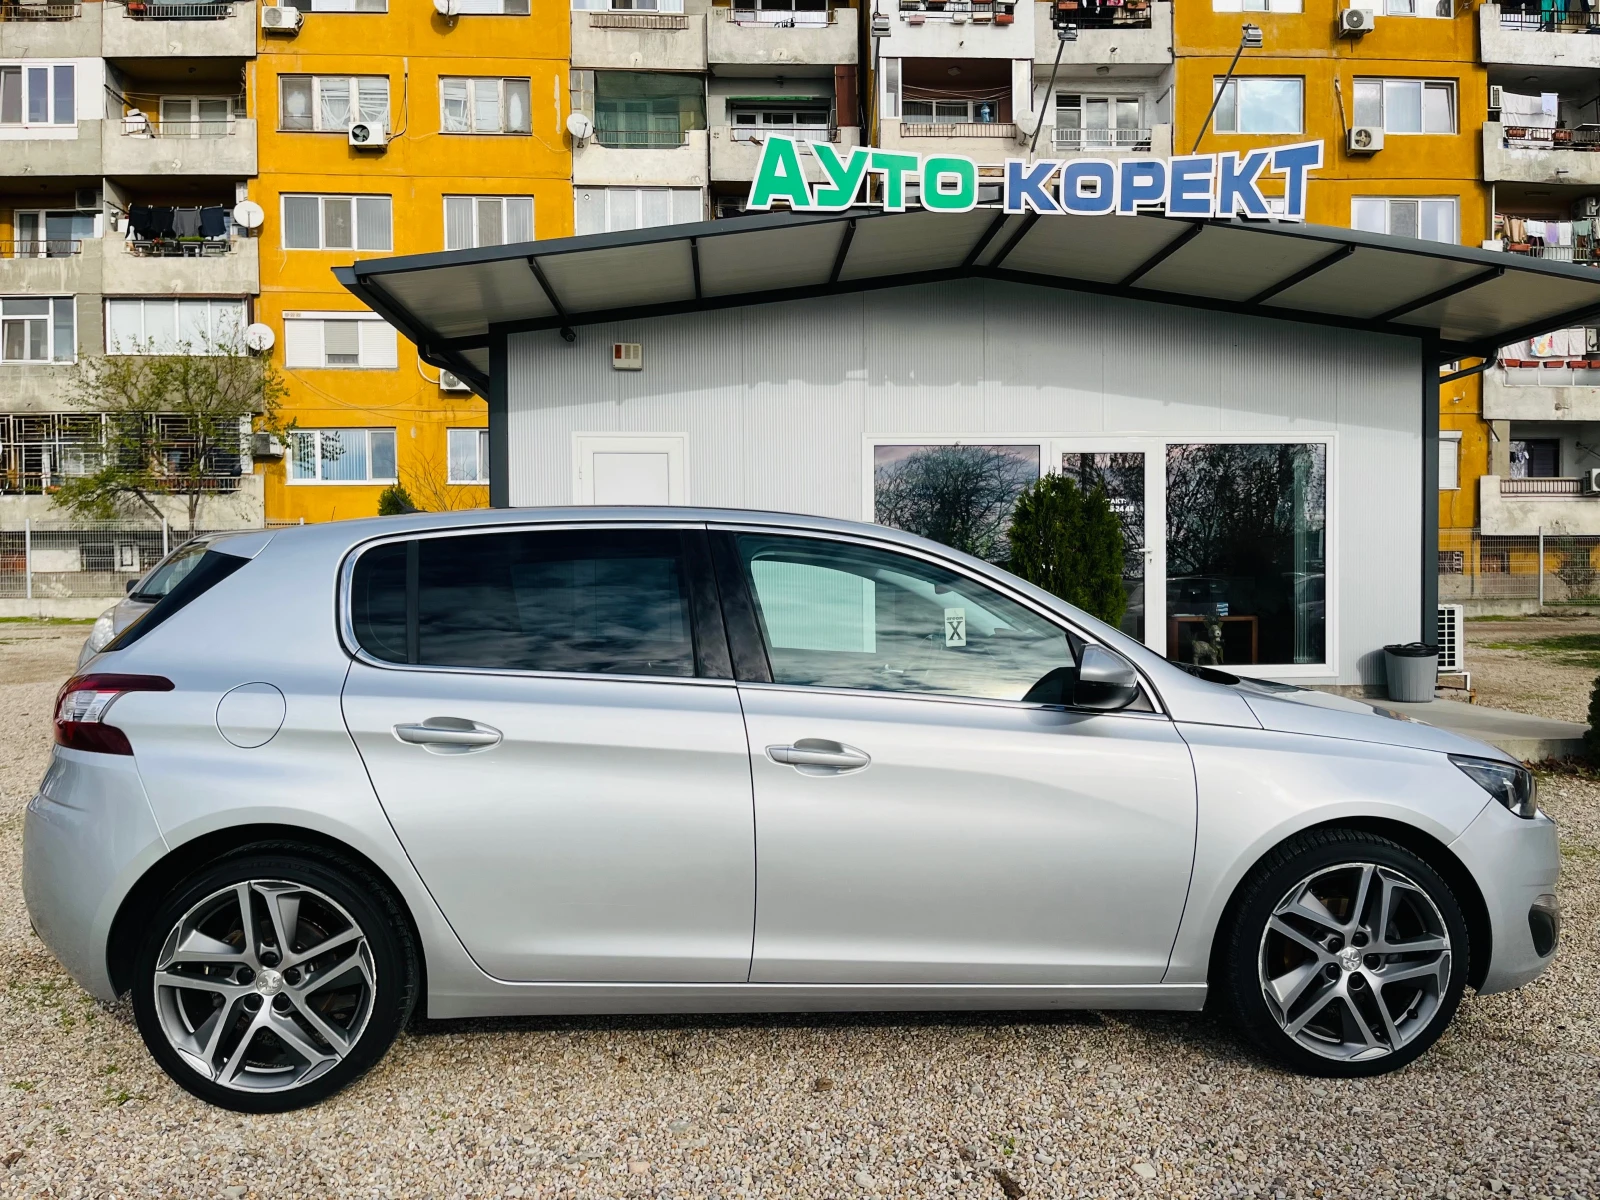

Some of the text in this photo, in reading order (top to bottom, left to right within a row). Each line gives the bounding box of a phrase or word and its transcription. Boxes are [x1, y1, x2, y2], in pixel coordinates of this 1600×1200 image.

[747, 132, 1324, 219] АУТО КОРЕКТ
[947, 621, 964, 640] X
